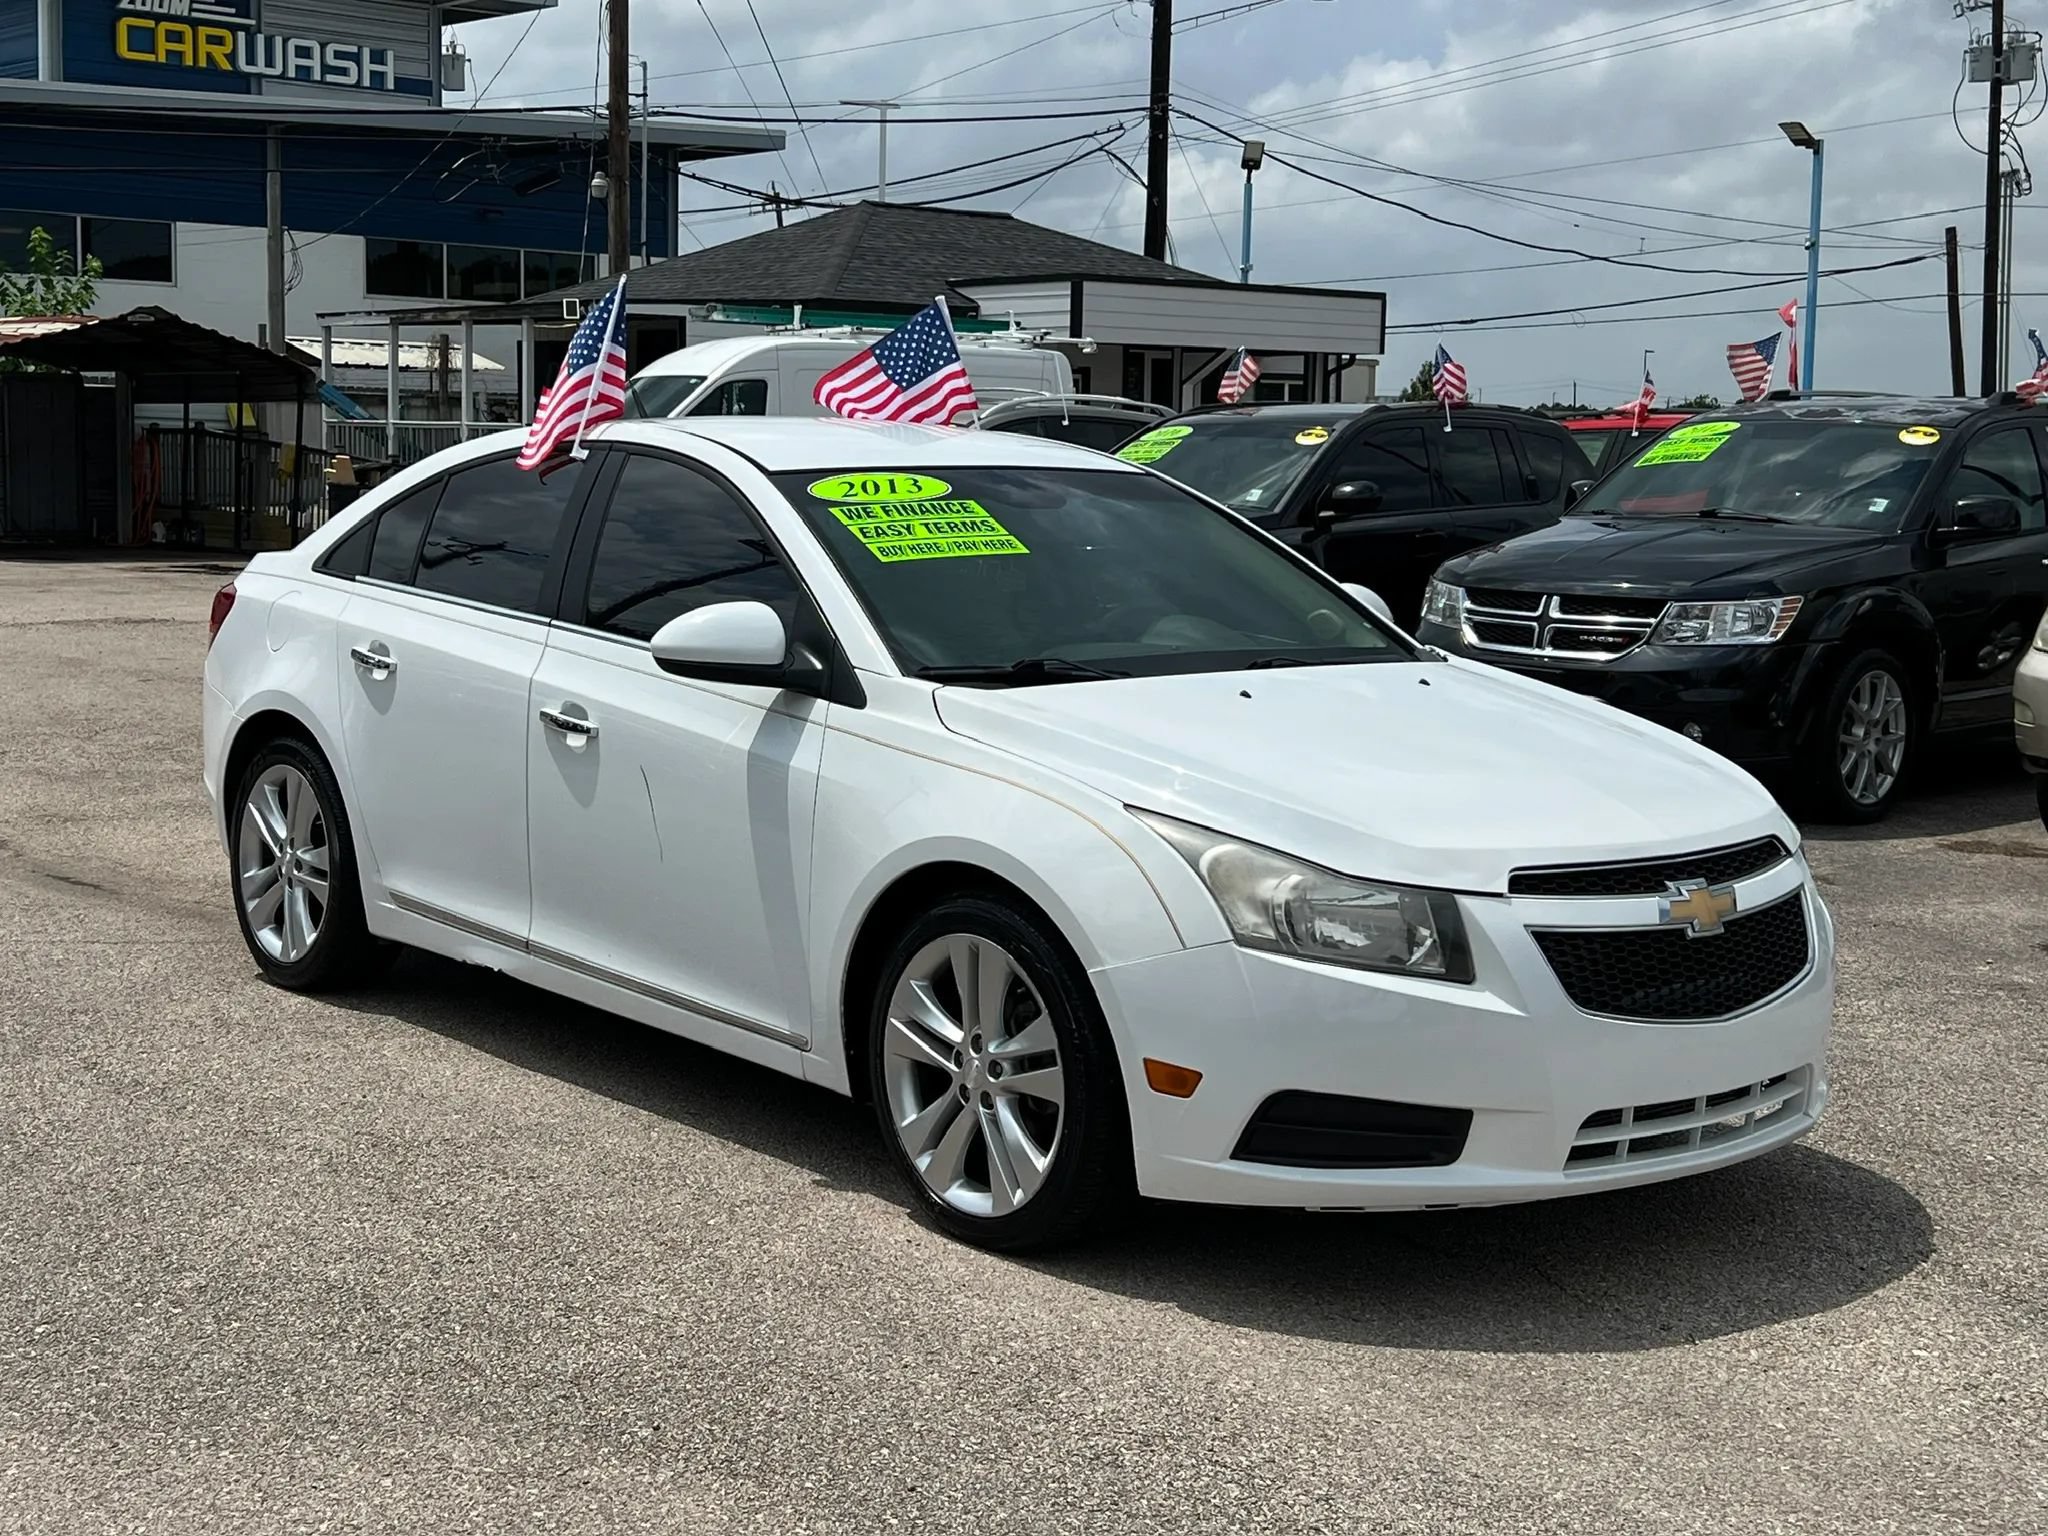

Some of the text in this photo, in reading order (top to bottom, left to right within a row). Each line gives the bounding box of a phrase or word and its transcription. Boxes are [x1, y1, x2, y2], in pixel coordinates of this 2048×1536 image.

[838, 477, 923, 498] 2013
[839, 501, 976, 521] WE FINANCE
[859, 519, 998, 540] EASY TERMS
[877, 544, 905, 557] BUY
[906, 541, 945, 555] HERE
[953, 540, 980, 552] PAY
[980, 538, 1017, 550] HERE
